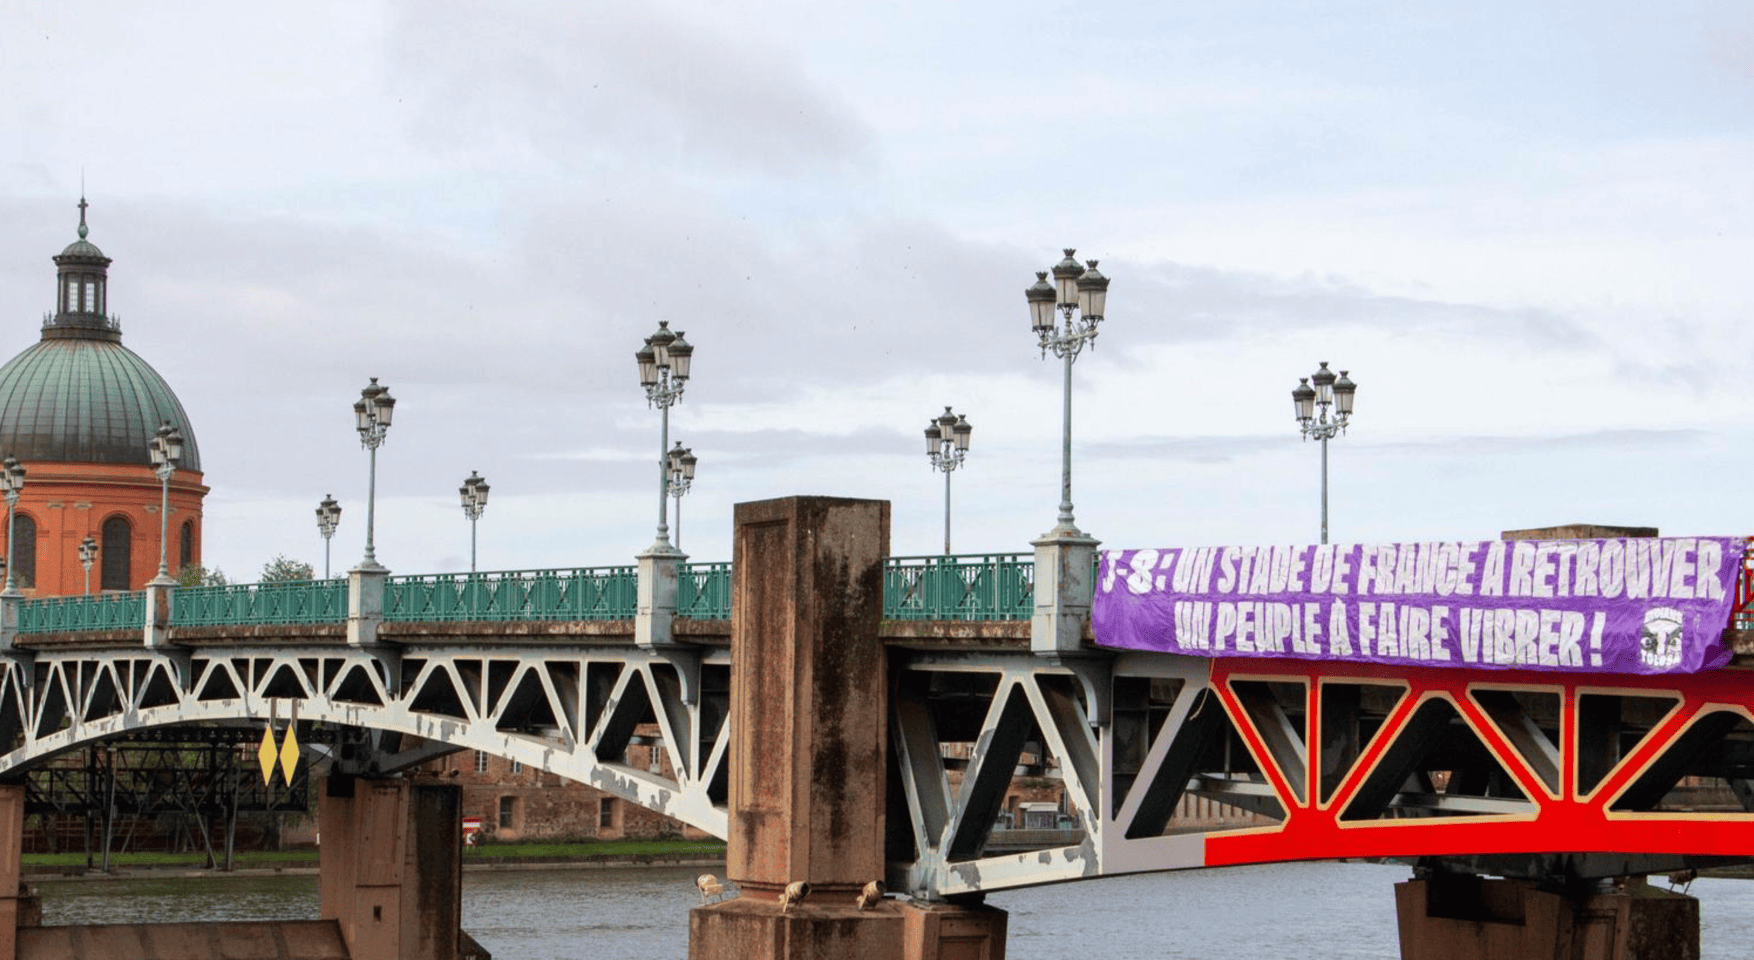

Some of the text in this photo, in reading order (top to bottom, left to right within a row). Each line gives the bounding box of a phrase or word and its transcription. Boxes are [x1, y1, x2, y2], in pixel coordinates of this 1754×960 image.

[1173, 547, 1217, 593] UN
[1217, 545, 1307, 594] STADE
[1311, 543, 1350, 594] DE
[1357, 542, 1477, 594] FRANCE
[1508, 539, 1724, 600] RETROUVER
[1174, 601, 1212, 650] UN
[1215, 601, 1322, 654] PEUPLE
[1329, 597, 1353, 655] À
[1358, 602, 1451, 660] FAIRE
[1459, 606, 1585, 666] VIBRER
